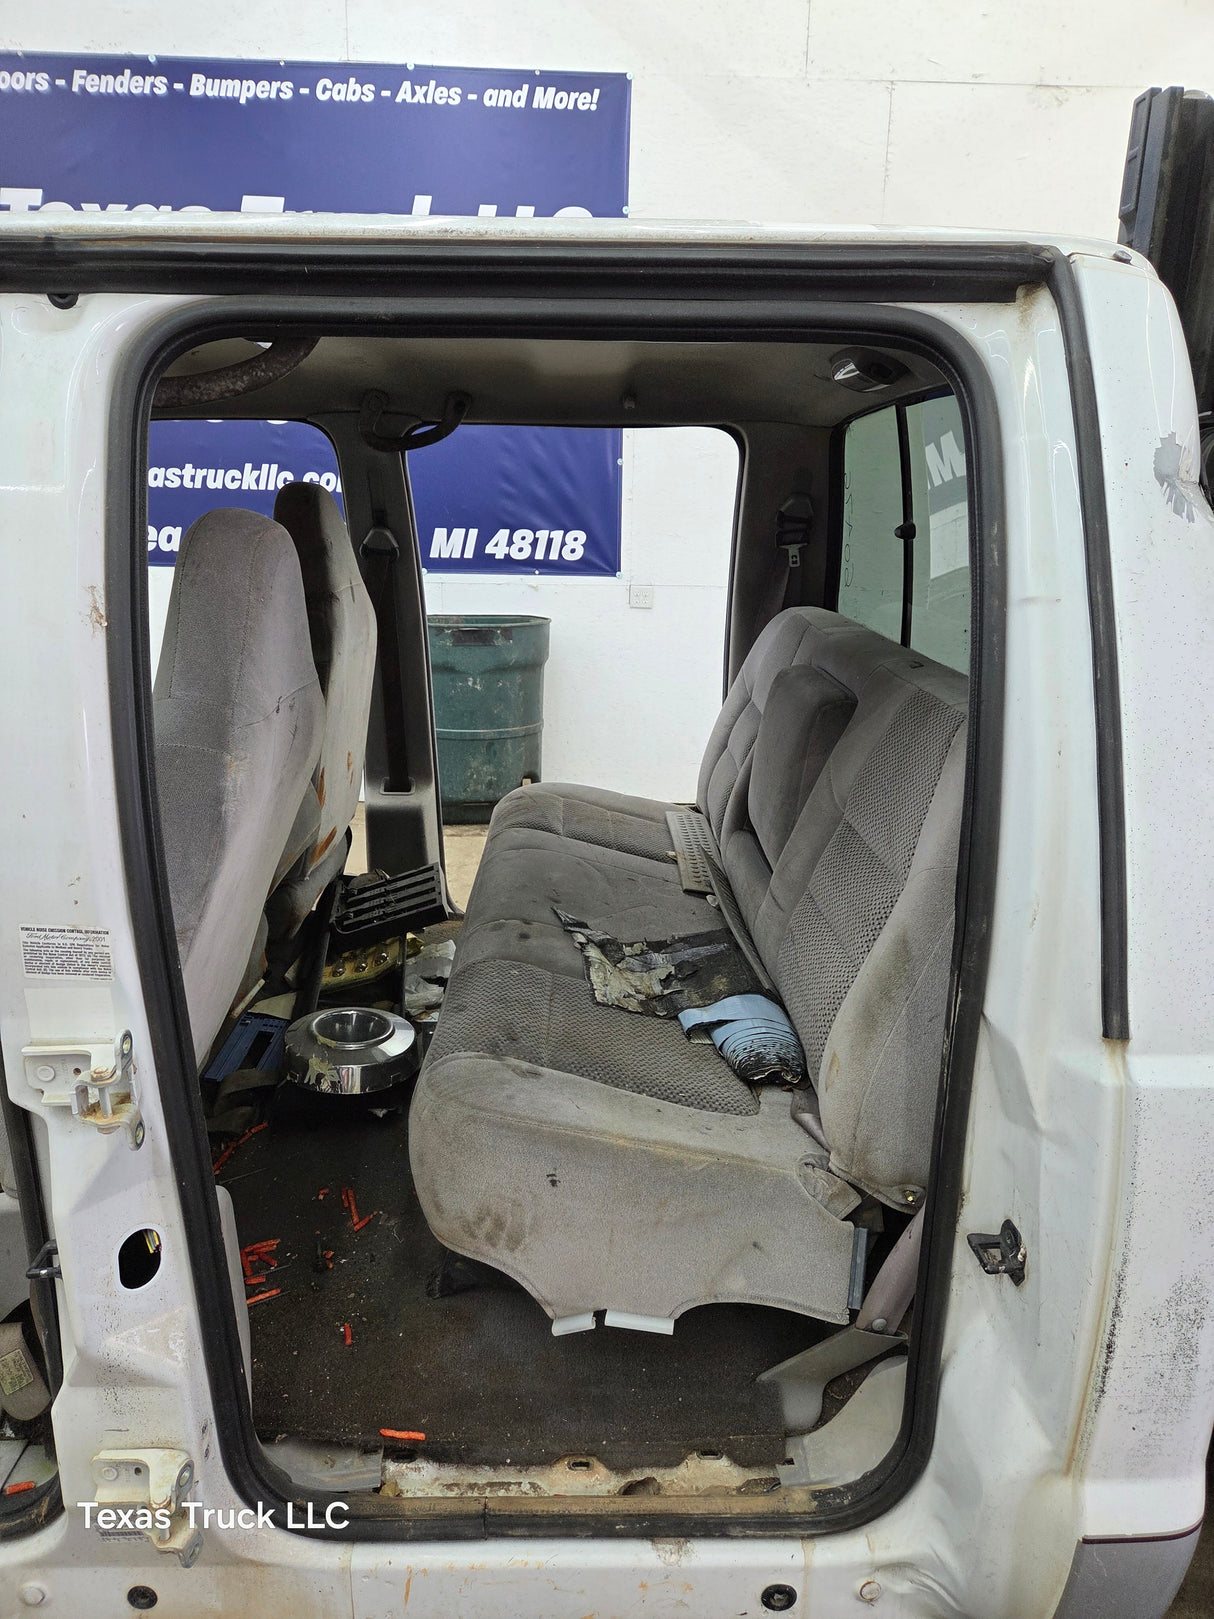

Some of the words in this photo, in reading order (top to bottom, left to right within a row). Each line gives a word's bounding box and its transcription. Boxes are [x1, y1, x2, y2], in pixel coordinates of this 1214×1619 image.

[71, 69, 168, 95] Fenders
[189, 73, 294, 104] Bumpers
[315, 77, 376, 103] Cabs
[394, 79, 463, 106] Axles
[483, 83, 530, 108] and
[532, 86, 601, 111] More!
[429, 527, 479, 559] MI
[484, 528, 587, 561] 48118
